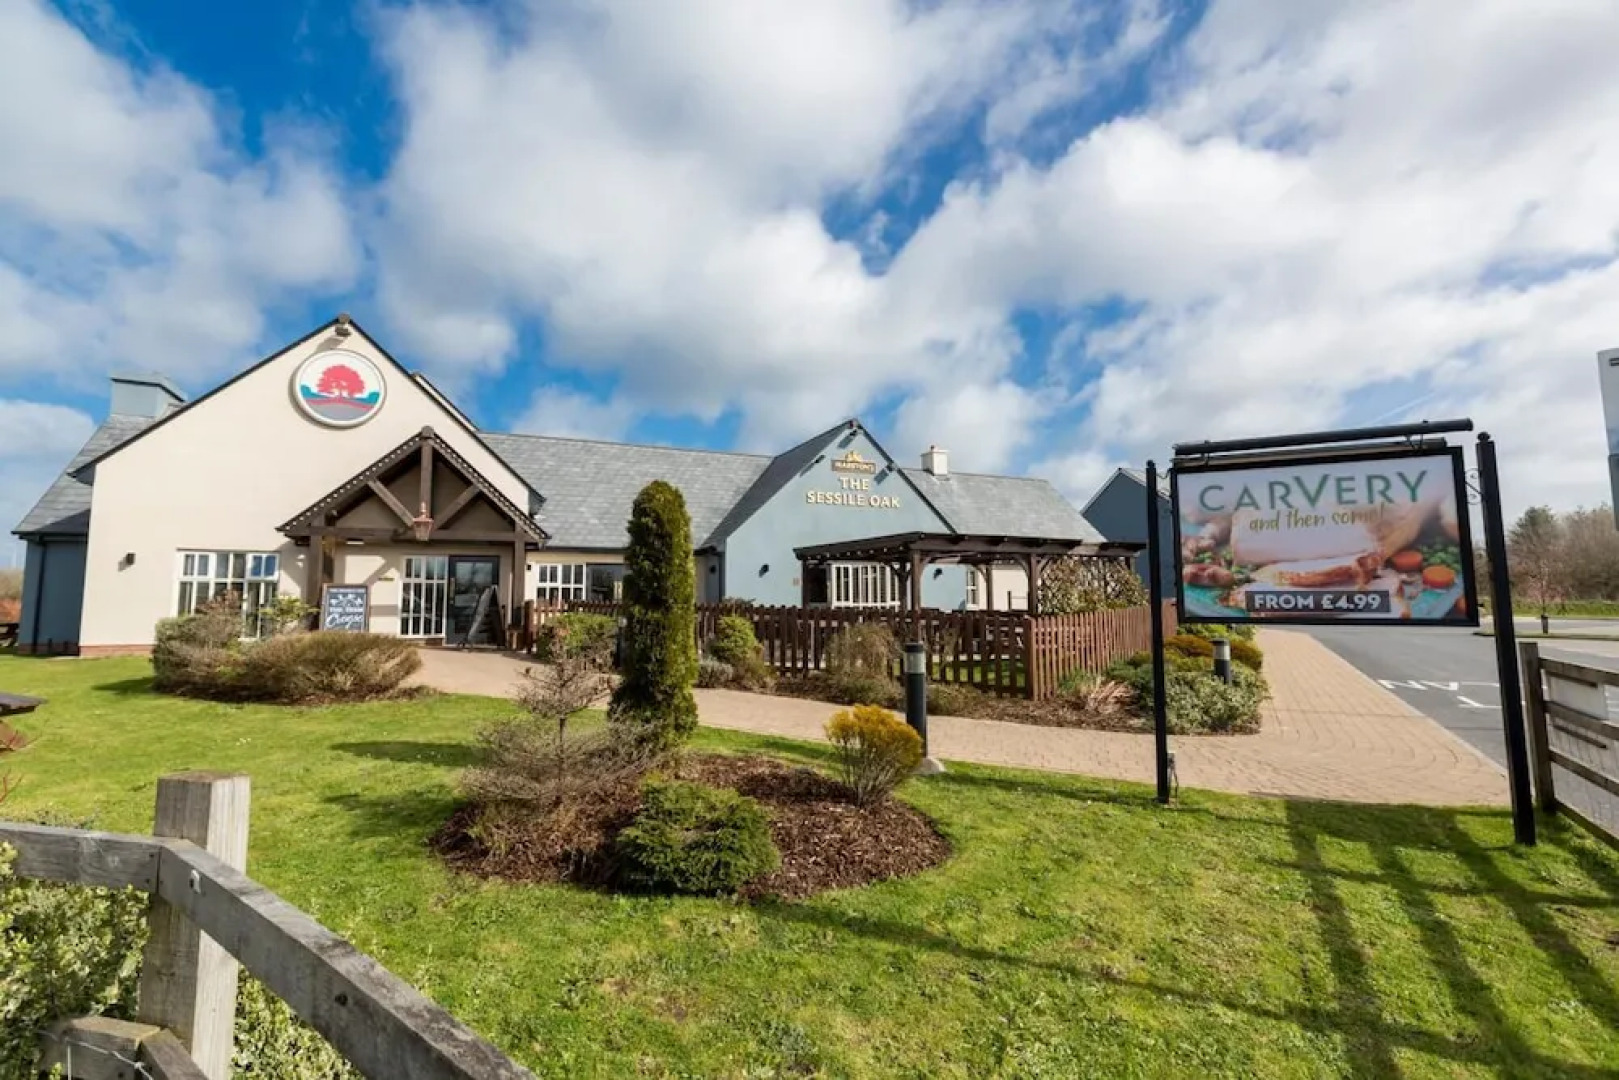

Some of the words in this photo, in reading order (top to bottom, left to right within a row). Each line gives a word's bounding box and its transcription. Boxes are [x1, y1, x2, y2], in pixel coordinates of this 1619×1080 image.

[839, 477, 870, 490] THE
[1198, 470, 1427, 511] CARVERY
[807, 491, 865, 506] SESSILE
[869, 495, 901, 508] OAK
[1249, 511, 1280, 532] and
[1286, 507, 1325, 530] then
[1254, 594, 1314, 610] FROM
[1321, 594, 1381, 610] £4.99
